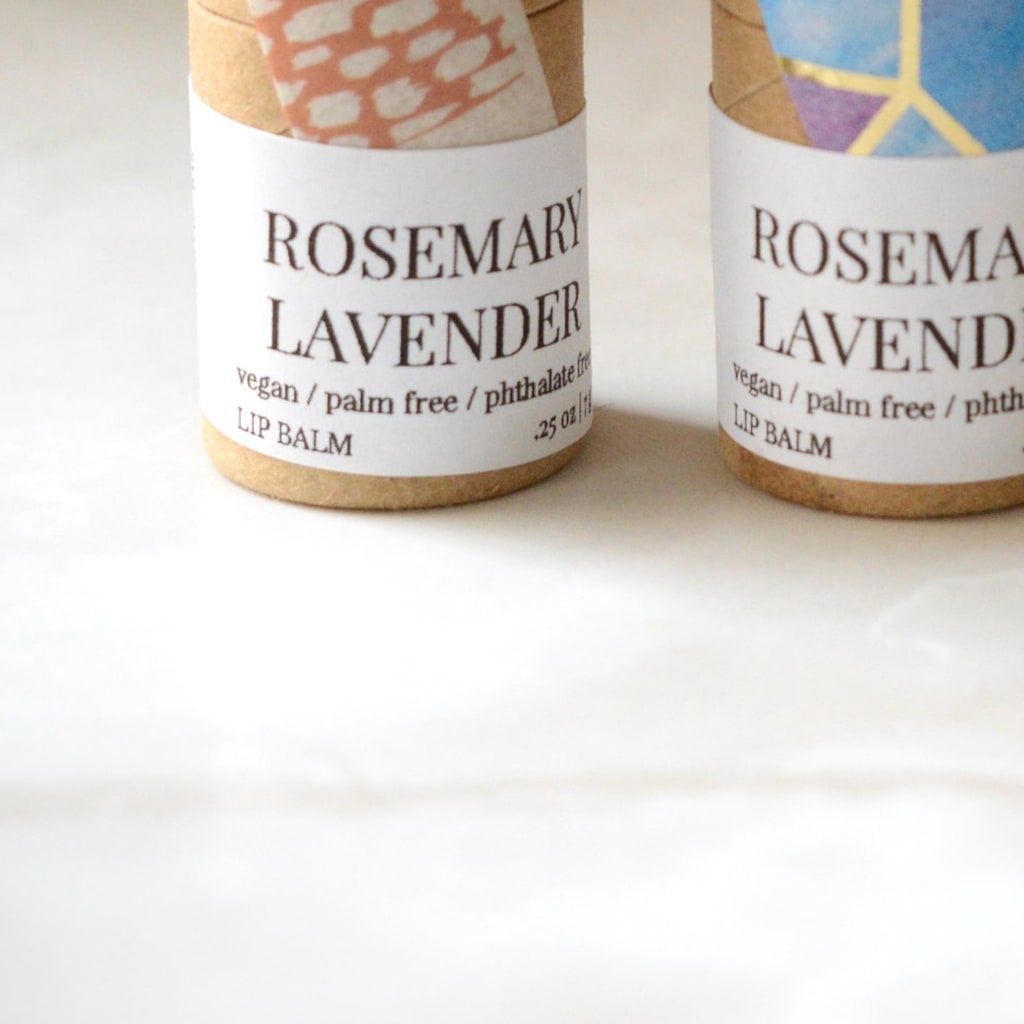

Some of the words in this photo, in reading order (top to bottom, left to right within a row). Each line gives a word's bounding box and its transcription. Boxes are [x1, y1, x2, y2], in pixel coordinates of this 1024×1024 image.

[263, 188, 583, 281] ROSEMARY
[266, 280, 582, 367] LAVENDER
[236, 367, 299, 404] vegan
[306, 383, 318, 407] /
[325, 388, 395, 415] palm
[404, 391, 459, 415] free
[466, 387, 478, 409] /
[484, 364, 574, 414] phthalate
[732, 361, 783, 402] vegan
[789, 382, 800, 404] /
[806, 389, 872, 418] palm
[881, 395, 936, 421] free
[944, 394, 956, 417] /
[236, 406, 271, 437] LIP
[277, 420, 353, 457] BALM
[534, 415, 557, 441] .25
[560, 406, 577, 430] oz
[732, 402, 760, 436] LIP
[764, 419, 833, 459] BALM
